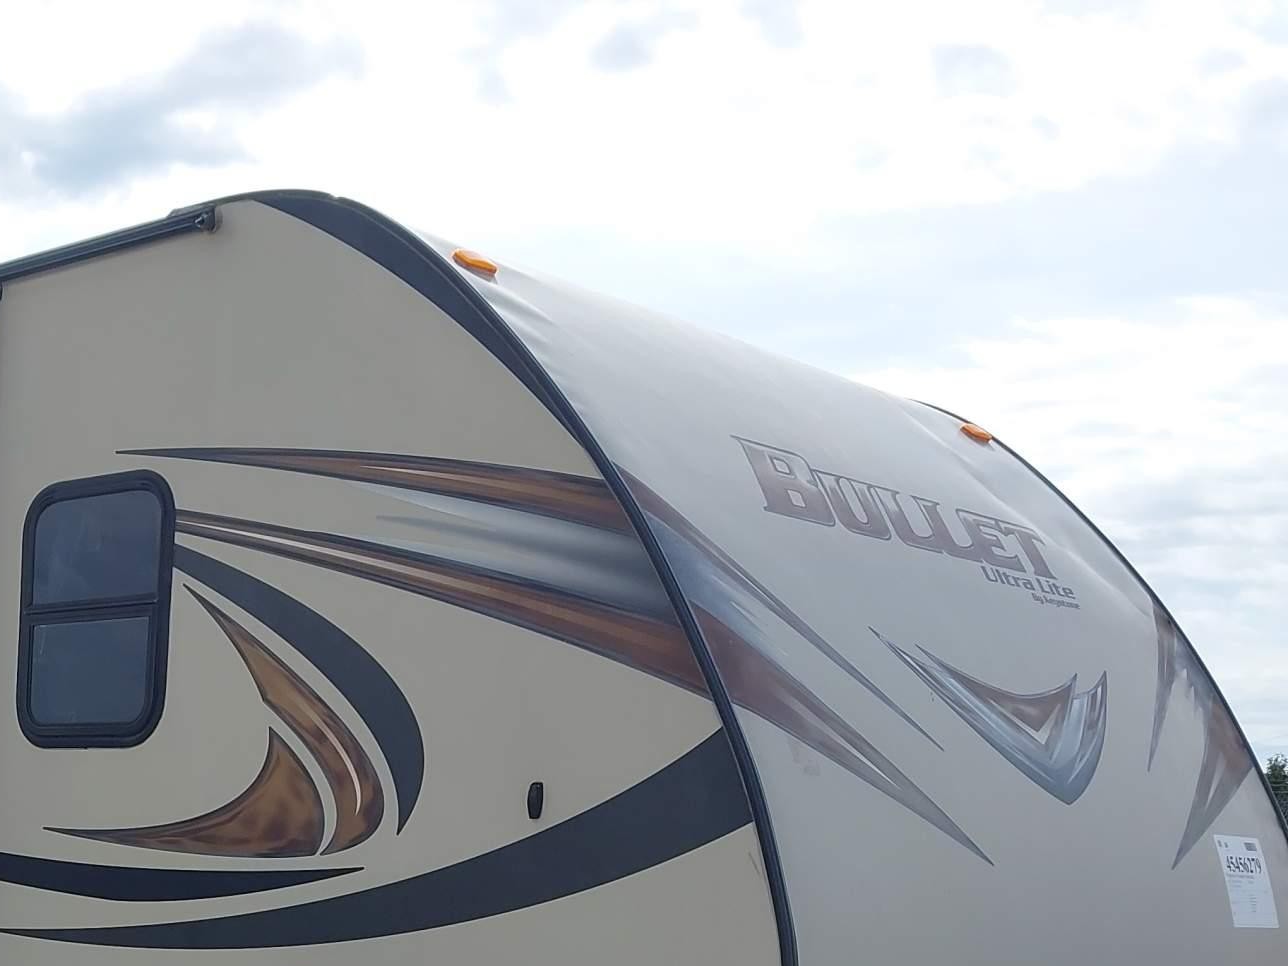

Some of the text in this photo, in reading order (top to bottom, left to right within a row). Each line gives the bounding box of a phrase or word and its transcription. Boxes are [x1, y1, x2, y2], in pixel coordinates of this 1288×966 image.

[730, 435, 1057, 579] BULLET
[980, 566, 1076, 599] Ultra Lite
[1226, 856, 1262, 874] 45456279
